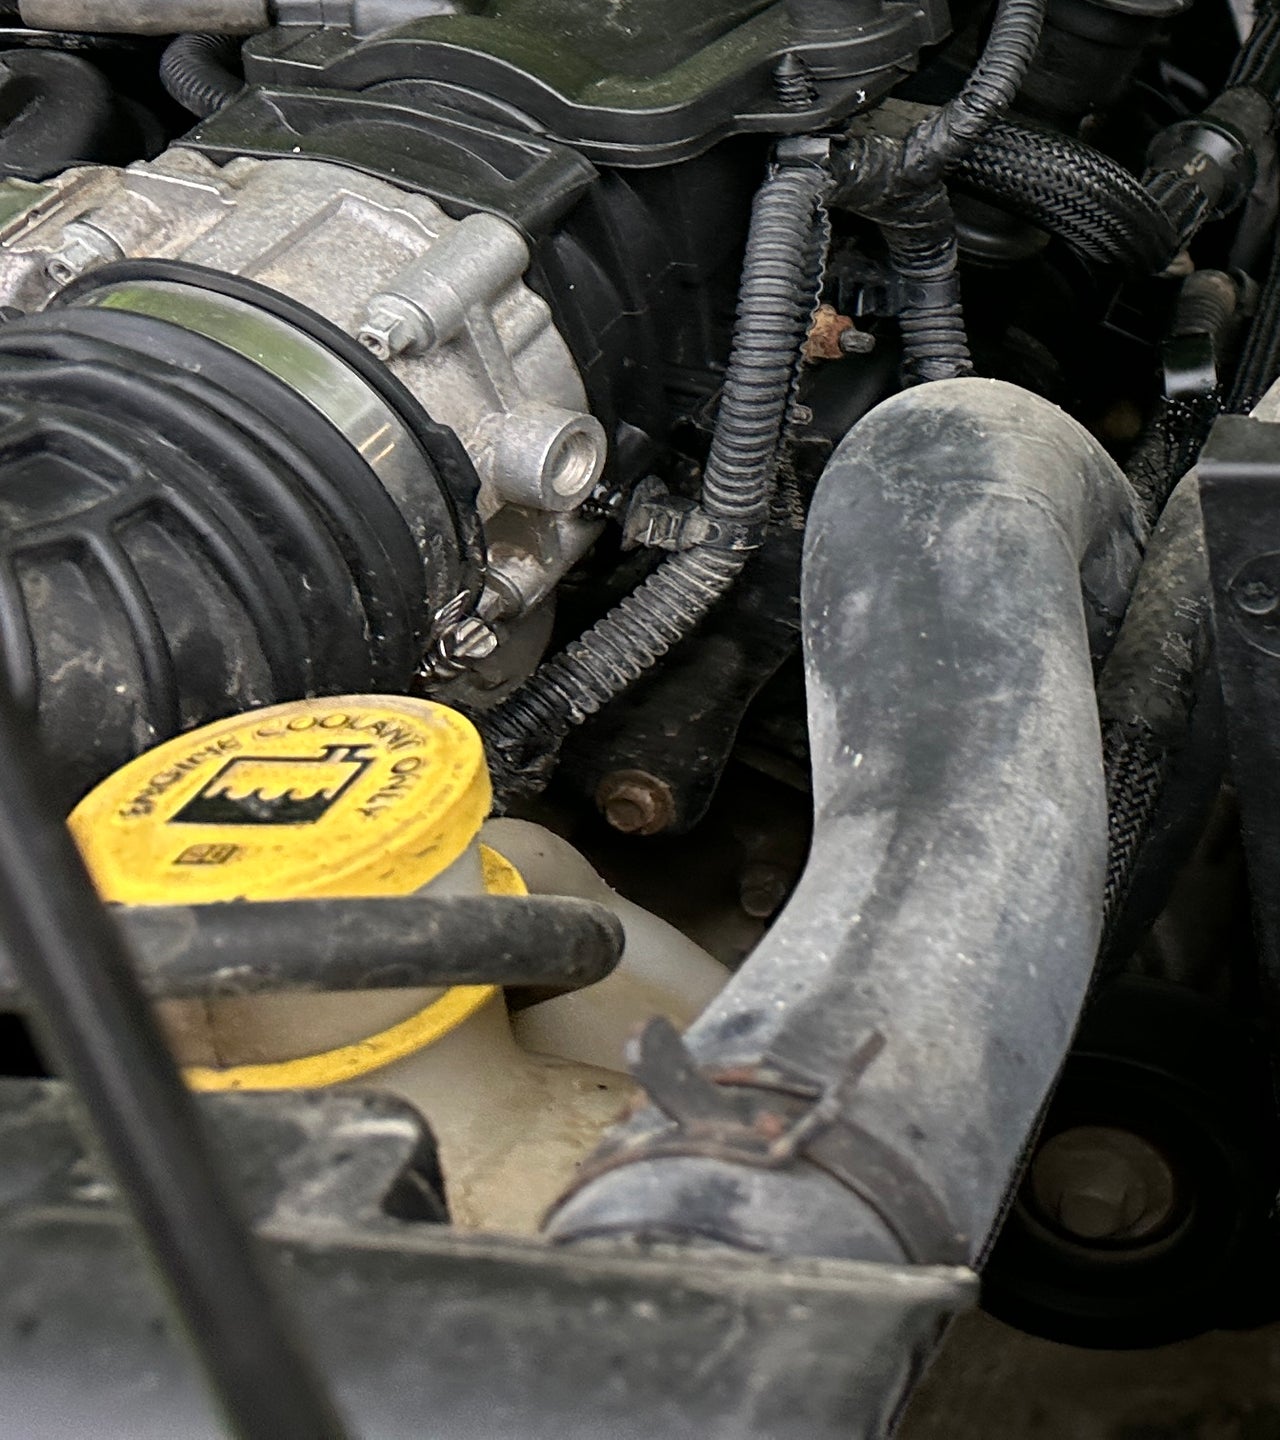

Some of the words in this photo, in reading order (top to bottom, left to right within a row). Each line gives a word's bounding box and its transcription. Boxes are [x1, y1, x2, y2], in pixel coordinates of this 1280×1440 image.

[118, 733, 243, 817] ENGINE
[252, 712, 427, 751] COOLANT
[355, 755, 424, 818] ONLY
